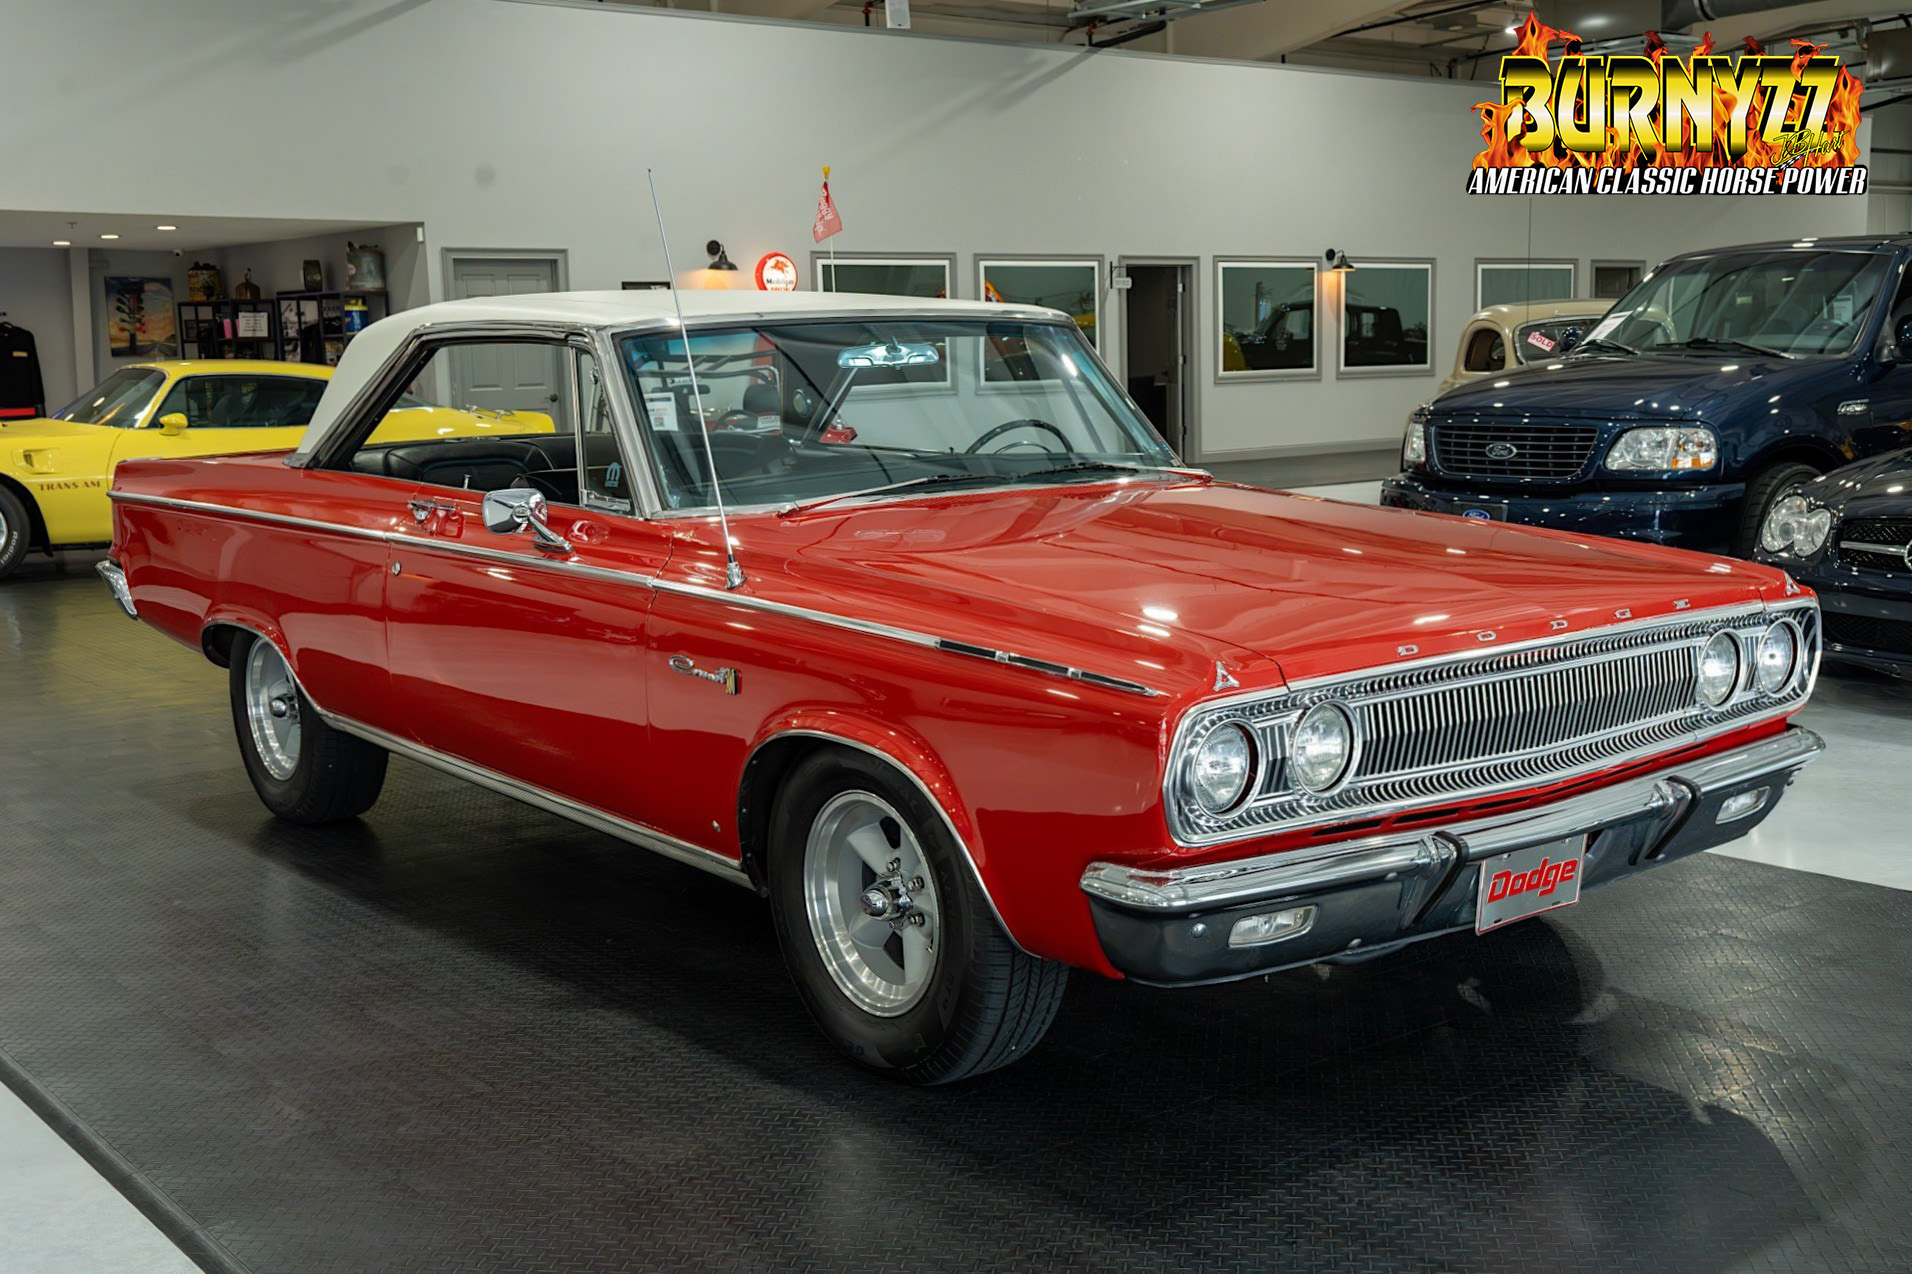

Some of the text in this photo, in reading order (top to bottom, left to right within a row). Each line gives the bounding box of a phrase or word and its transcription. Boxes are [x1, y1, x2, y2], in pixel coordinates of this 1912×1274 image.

[1530, 333, 1553, 348] SOLD
[40, 480, 101, 491] TRANS AM
[1397, 598, 1691, 656] DODGE
[1486, 856, 1579, 903] Dodge
